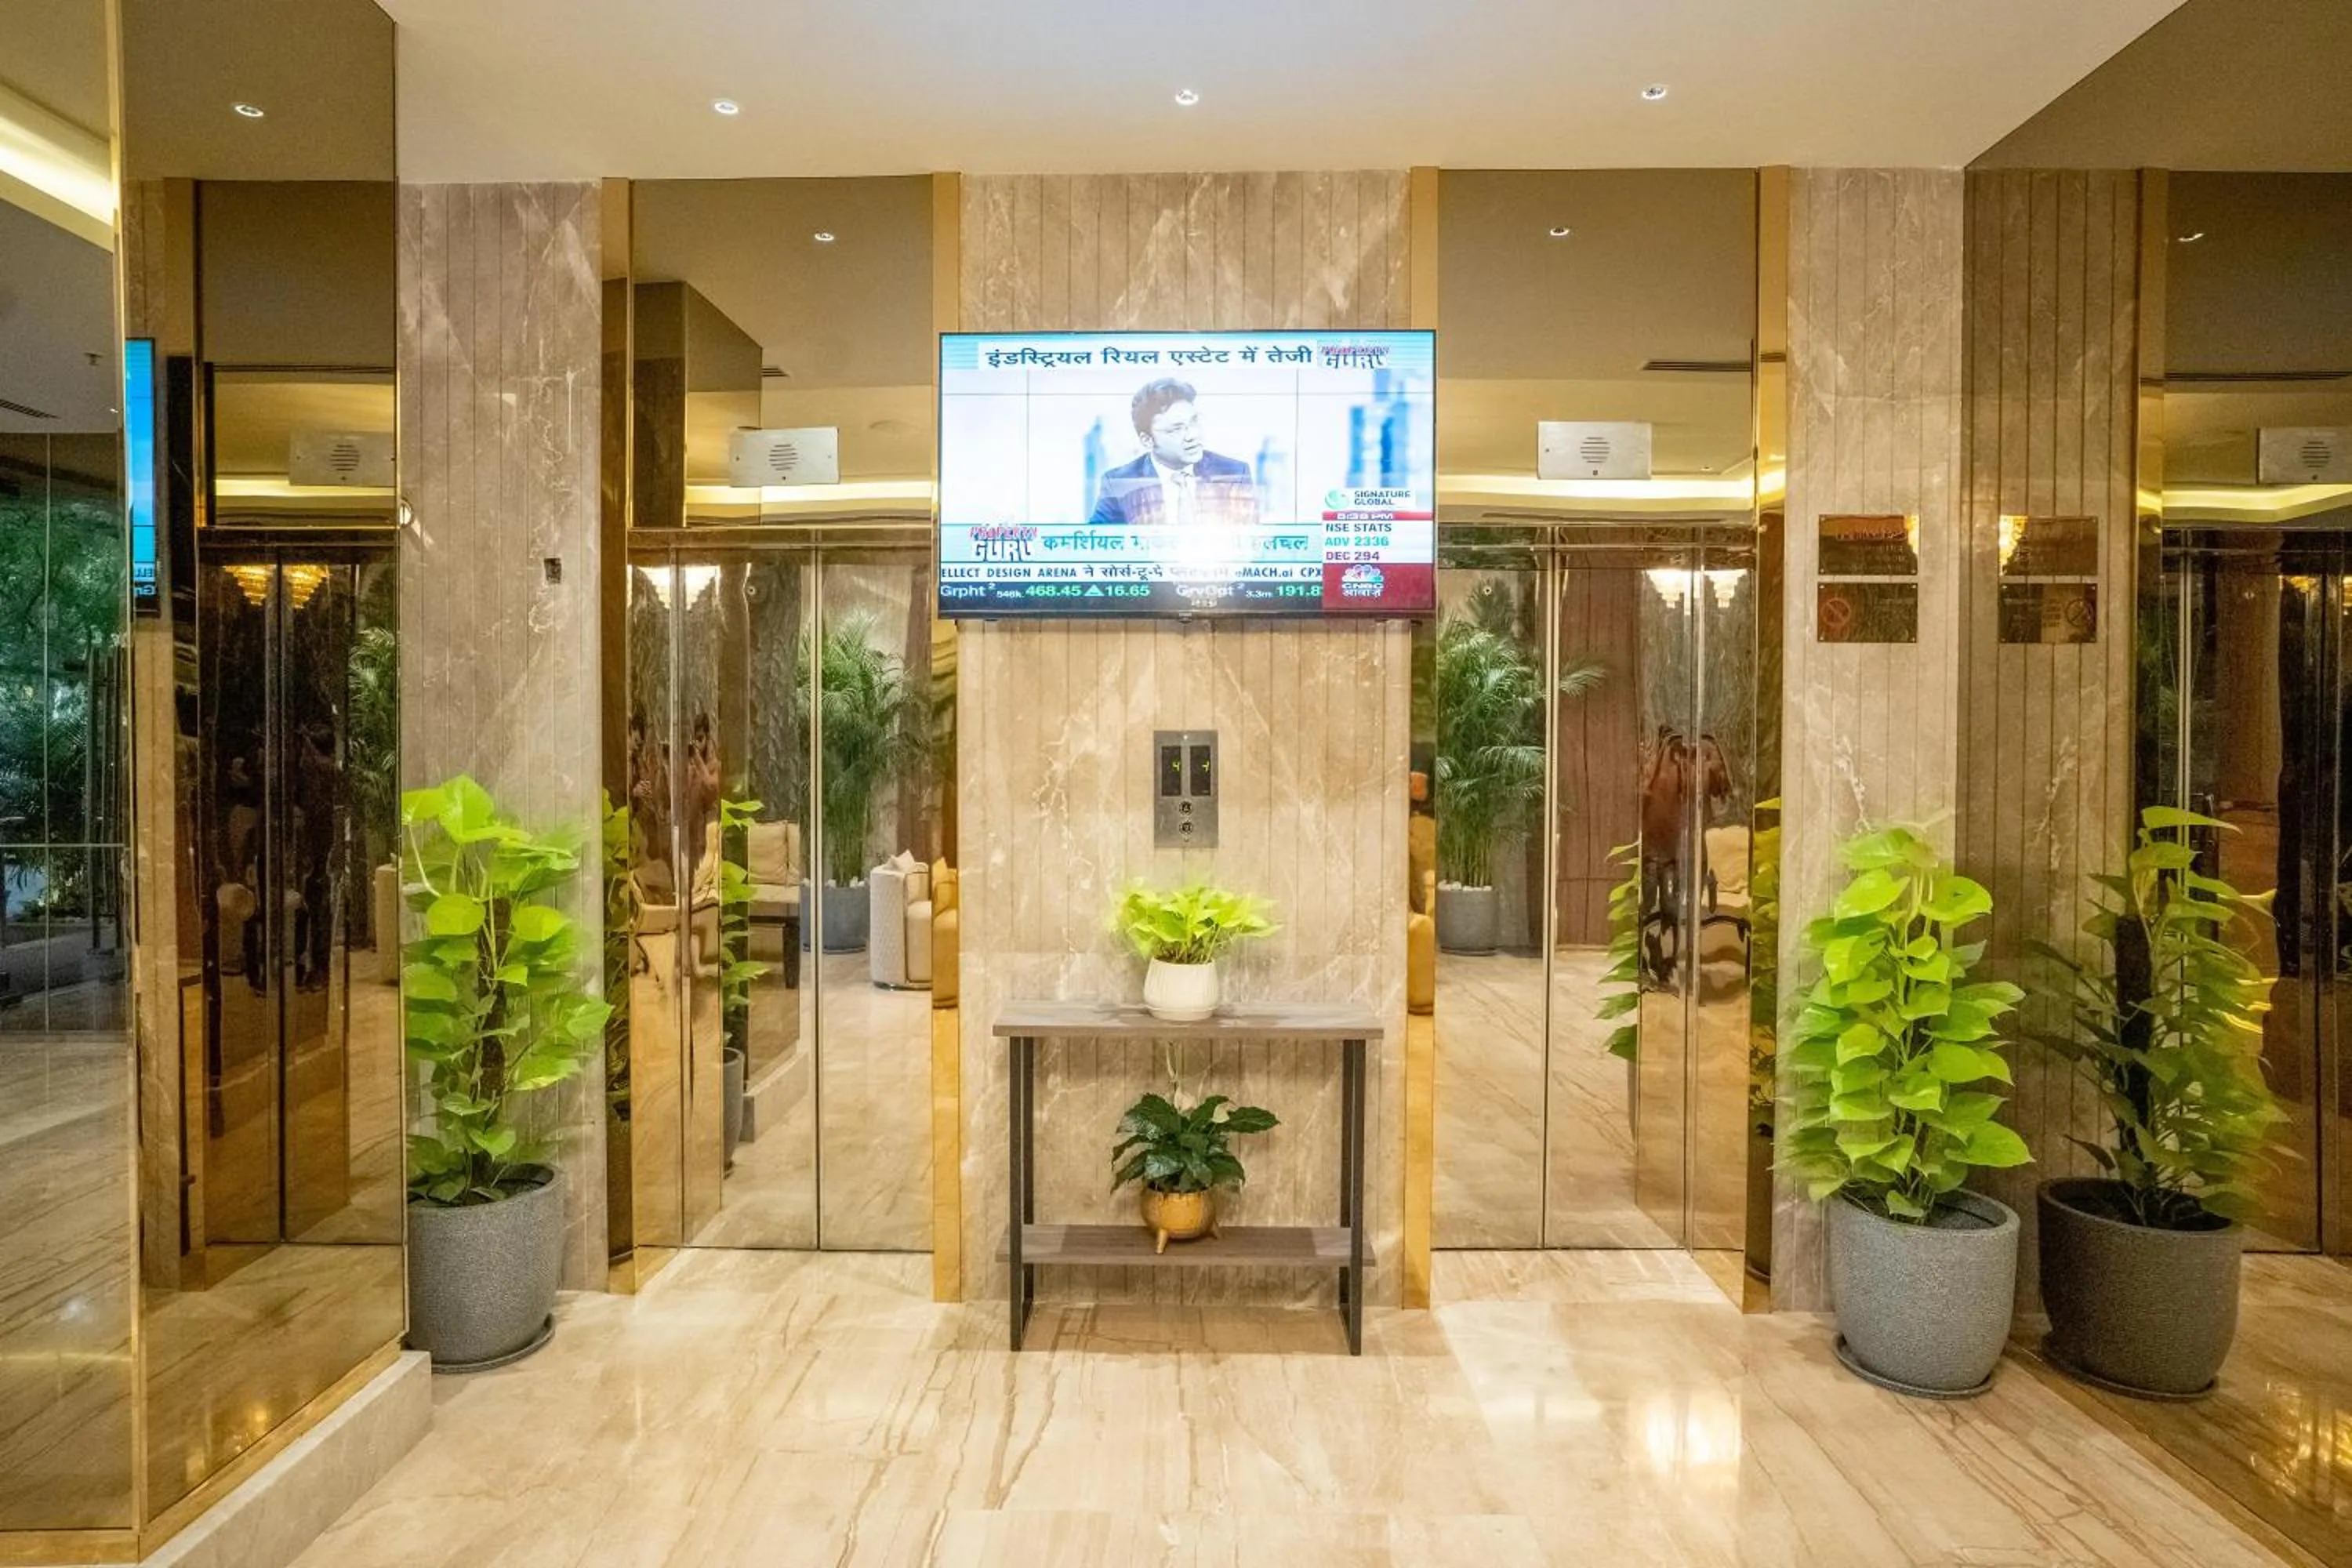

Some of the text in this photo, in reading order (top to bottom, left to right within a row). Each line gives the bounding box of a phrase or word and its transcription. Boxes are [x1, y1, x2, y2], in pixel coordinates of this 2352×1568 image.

[985, 345, 1313, 368] इंडस्ट्रियल रियल एस्टेट में तेजी
[1326, 523, 1392, 532] NSE STATS
[1325, 536, 1389, 546] ADV 2336
[1326, 551, 1380, 561] DEC 294
[942, 568, 981, 578] ELLECT
[987, 568, 1031, 578] DESIGN
[1037, 568, 1077, 578] ARENA
[941, 584, 985, 599] Grpht
[1025, 585, 1081, 597] 468.45
[1105, 585, 1151, 597] 16.65
[1276, 584, 1323, 597] 191.8
